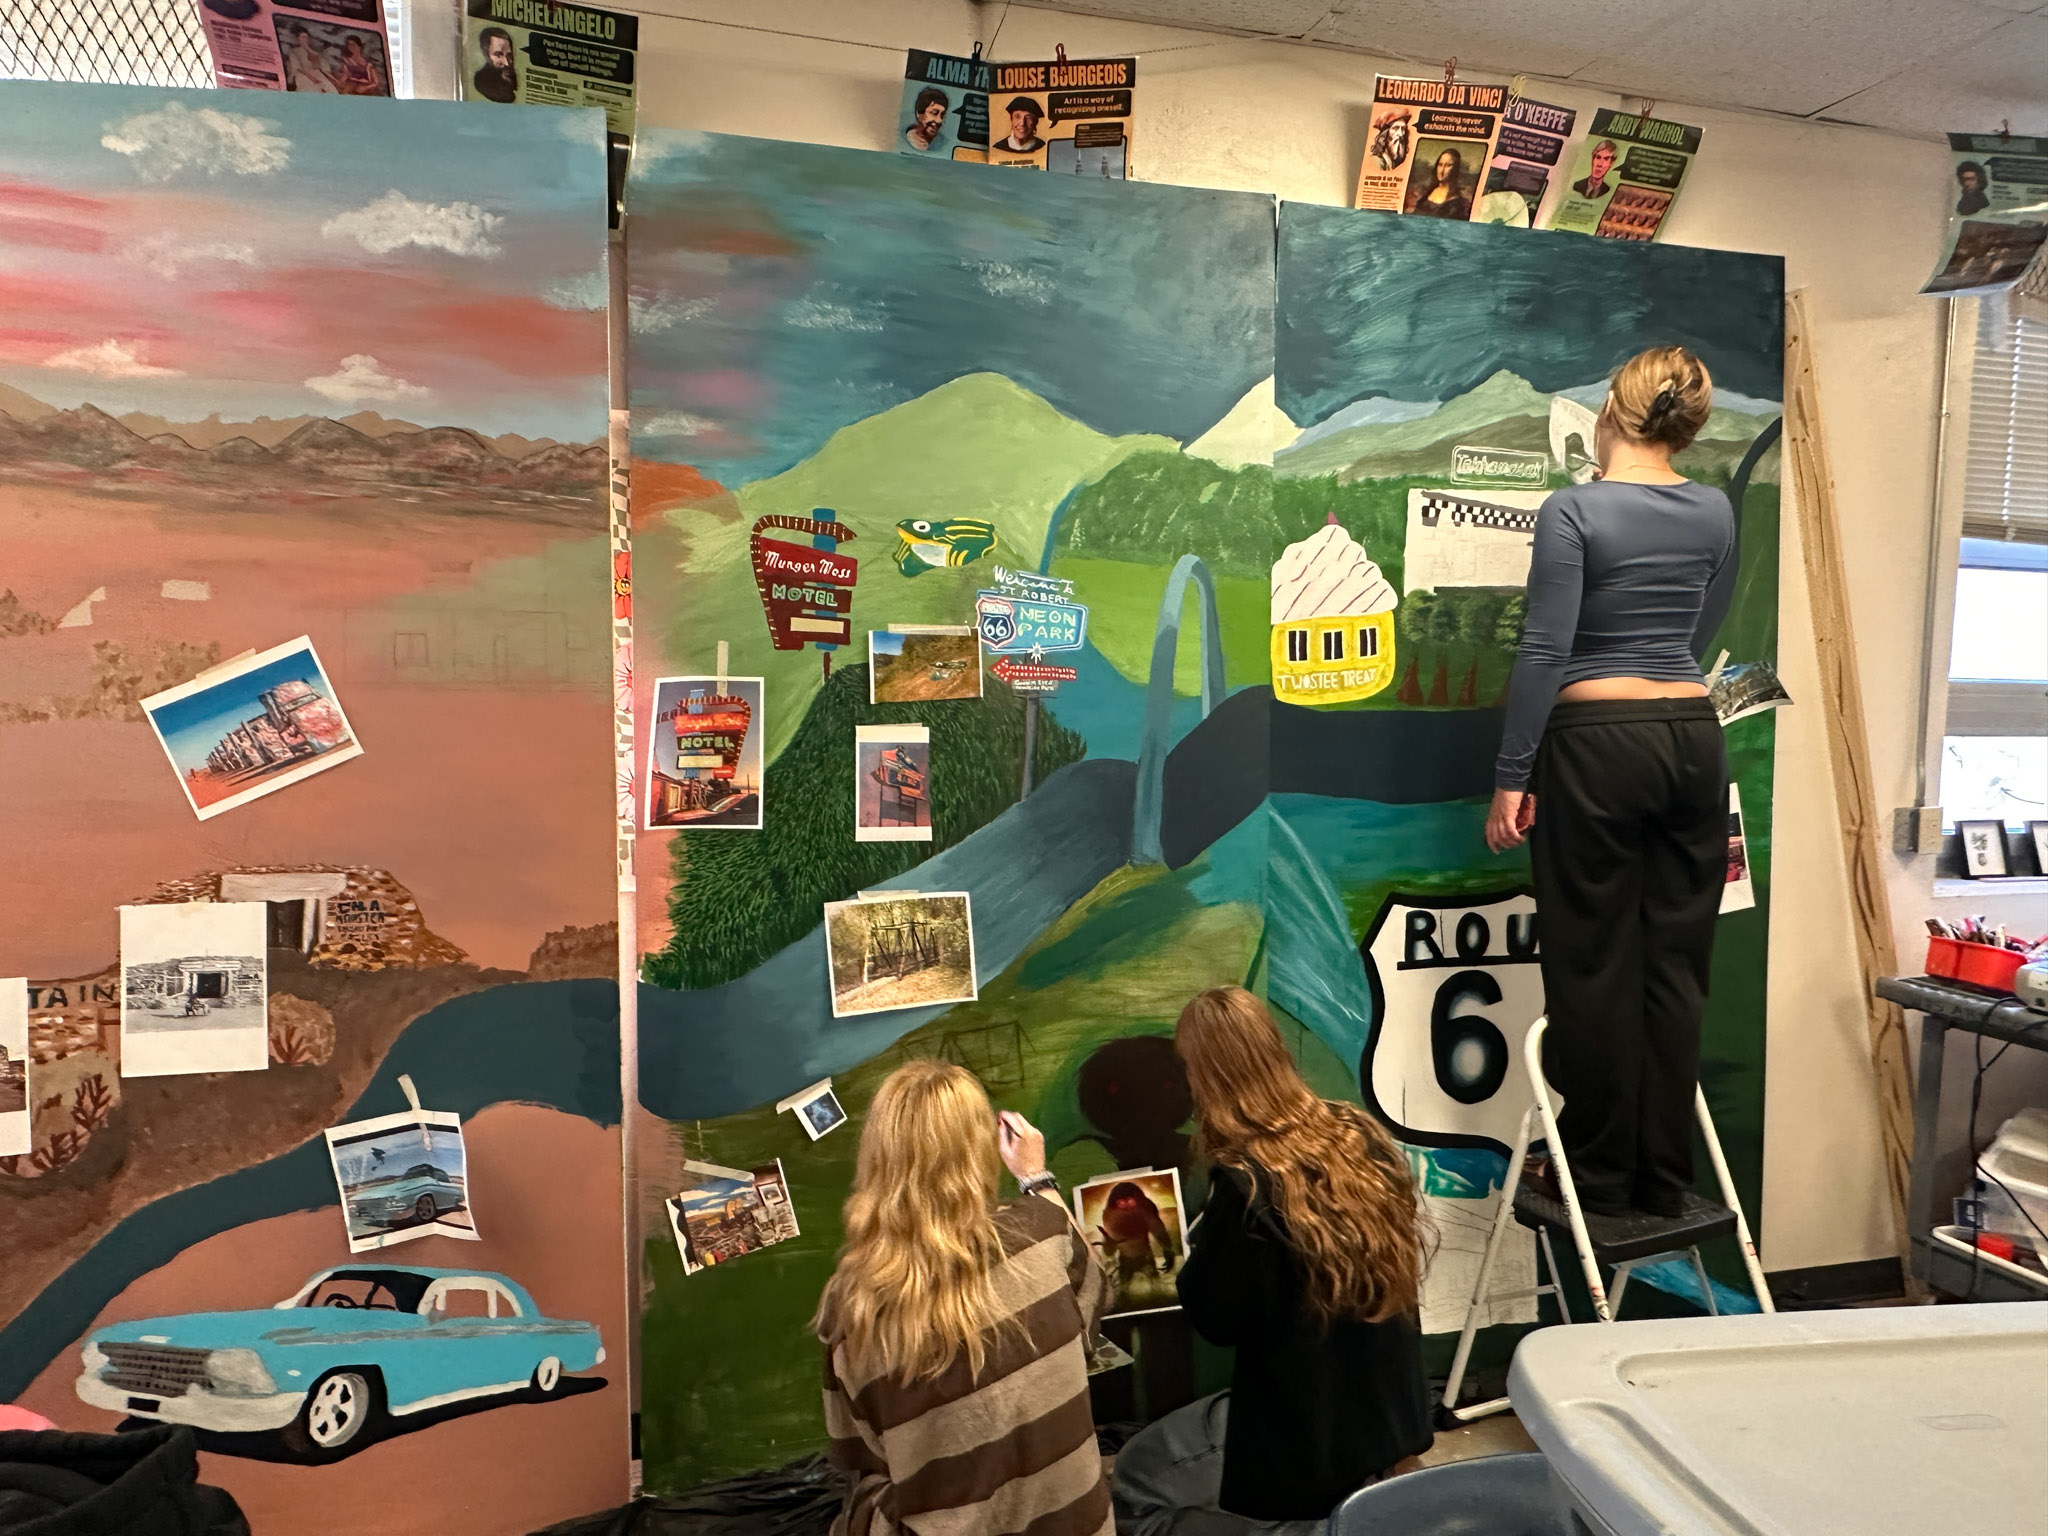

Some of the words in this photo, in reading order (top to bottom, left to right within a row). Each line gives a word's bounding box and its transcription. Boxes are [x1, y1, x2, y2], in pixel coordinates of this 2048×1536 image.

[492, 0, 616, 40] MICHELANGELO
[927, 58, 970, 85] ALMA
[997, 67, 1045, 89] LOUISE
[1050, 63, 1127, 87] BOURGEOIS
[1378, 79, 1445, 103] LEONARDO
[1448, 85, 1465, 105] DA
[1469, 86, 1503, 108] VINCI
[1514, 102, 1568, 131] O'KEEFFE
[1607, 114, 1641, 136] ANDY
[1639, 120, 1685, 145] WARHOL
[765, 551, 815, 574] Munger
[819, 559, 851, 579] Moss
[993, 565, 1059, 591] Welcome
[771, 583, 838, 607] MOTEL
[1000, 586, 1016, 595] ST
[1021, 589, 1069, 605] ROBERT
[983, 617, 1008, 637] 66
[1020, 606, 1076, 627] NEON
[1018, 623, 1076, 641] PARK
[1340, 668, 1377, 688] TREAT
[27, 984, 116, 1010] TAIN
[1431, 970, 1509, 1105] 6
